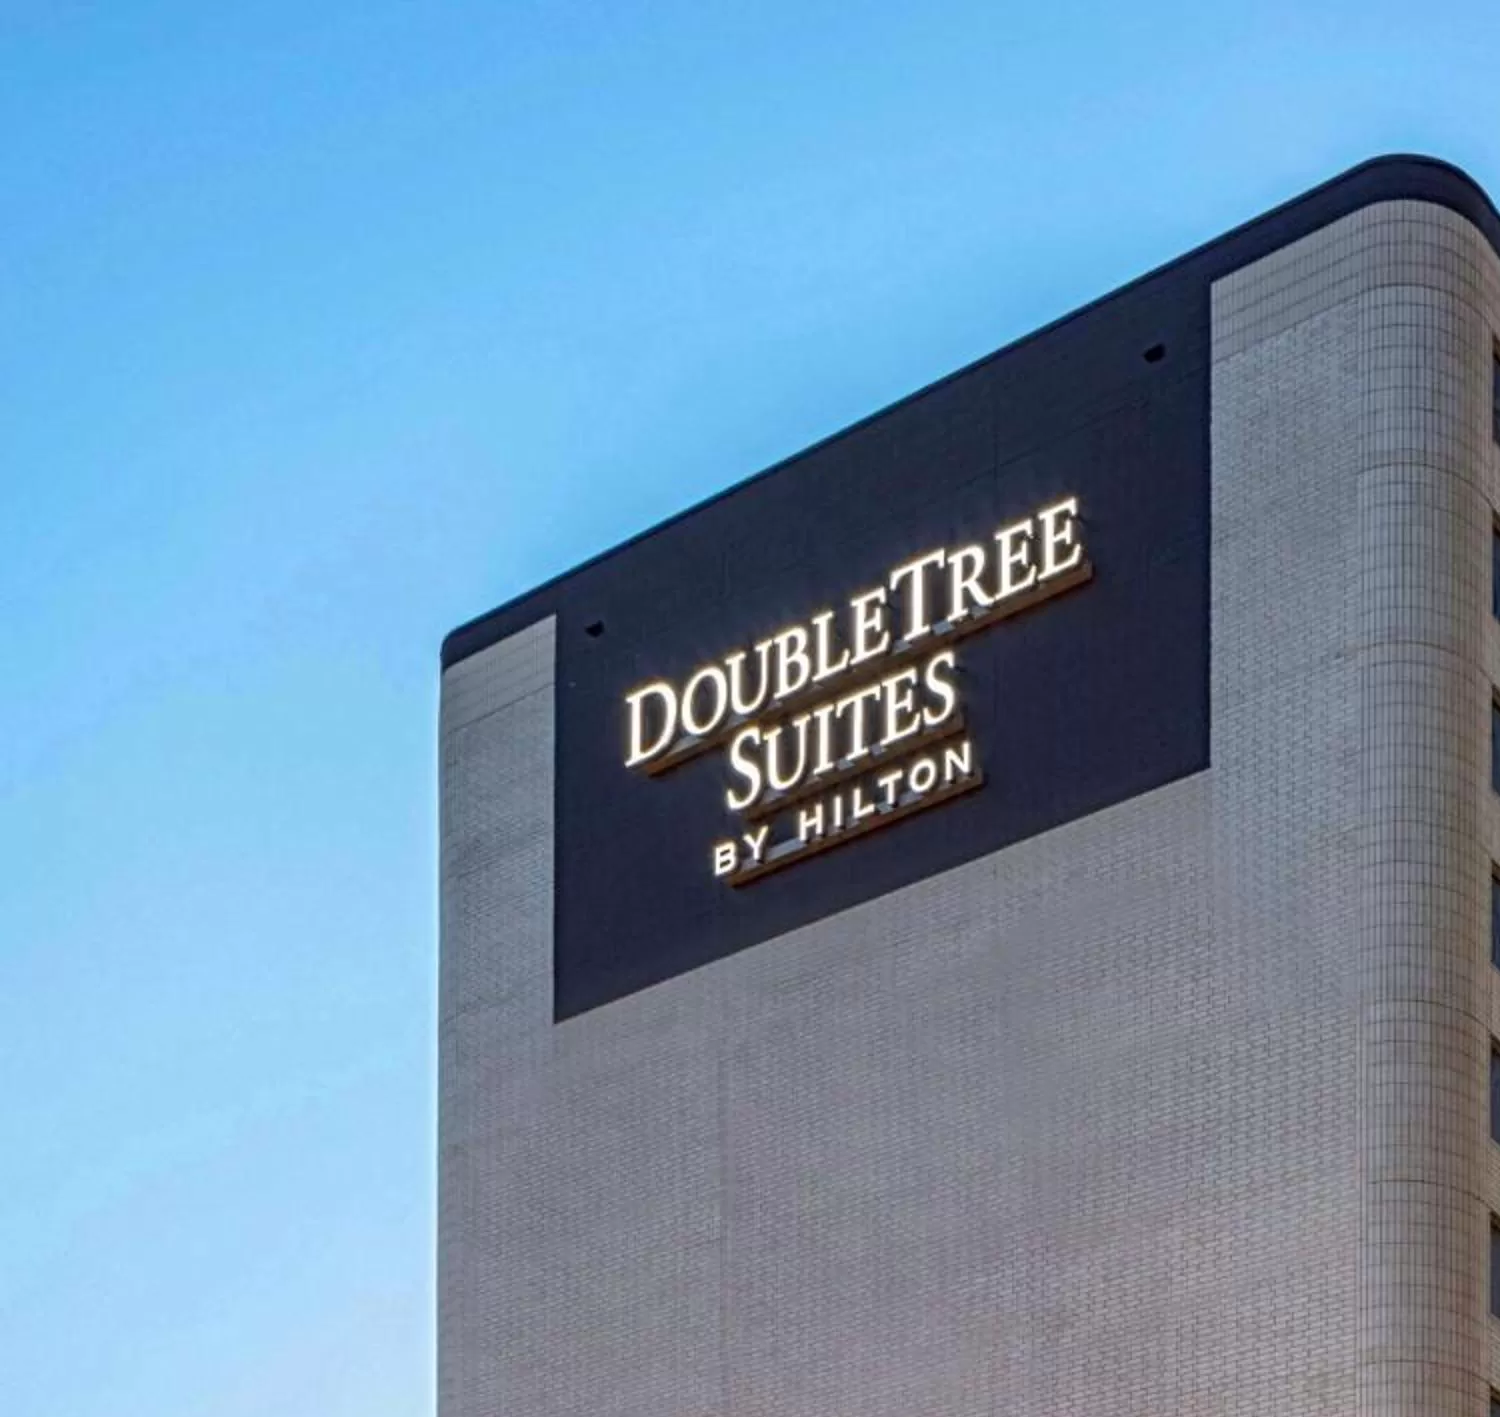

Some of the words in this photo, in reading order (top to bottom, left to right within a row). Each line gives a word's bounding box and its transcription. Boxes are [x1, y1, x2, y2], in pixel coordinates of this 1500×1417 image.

[726, 650, 957, 812] SUITES
[714, 826, 769, 876] BY
[799, 741, 972, 842] HILTON
